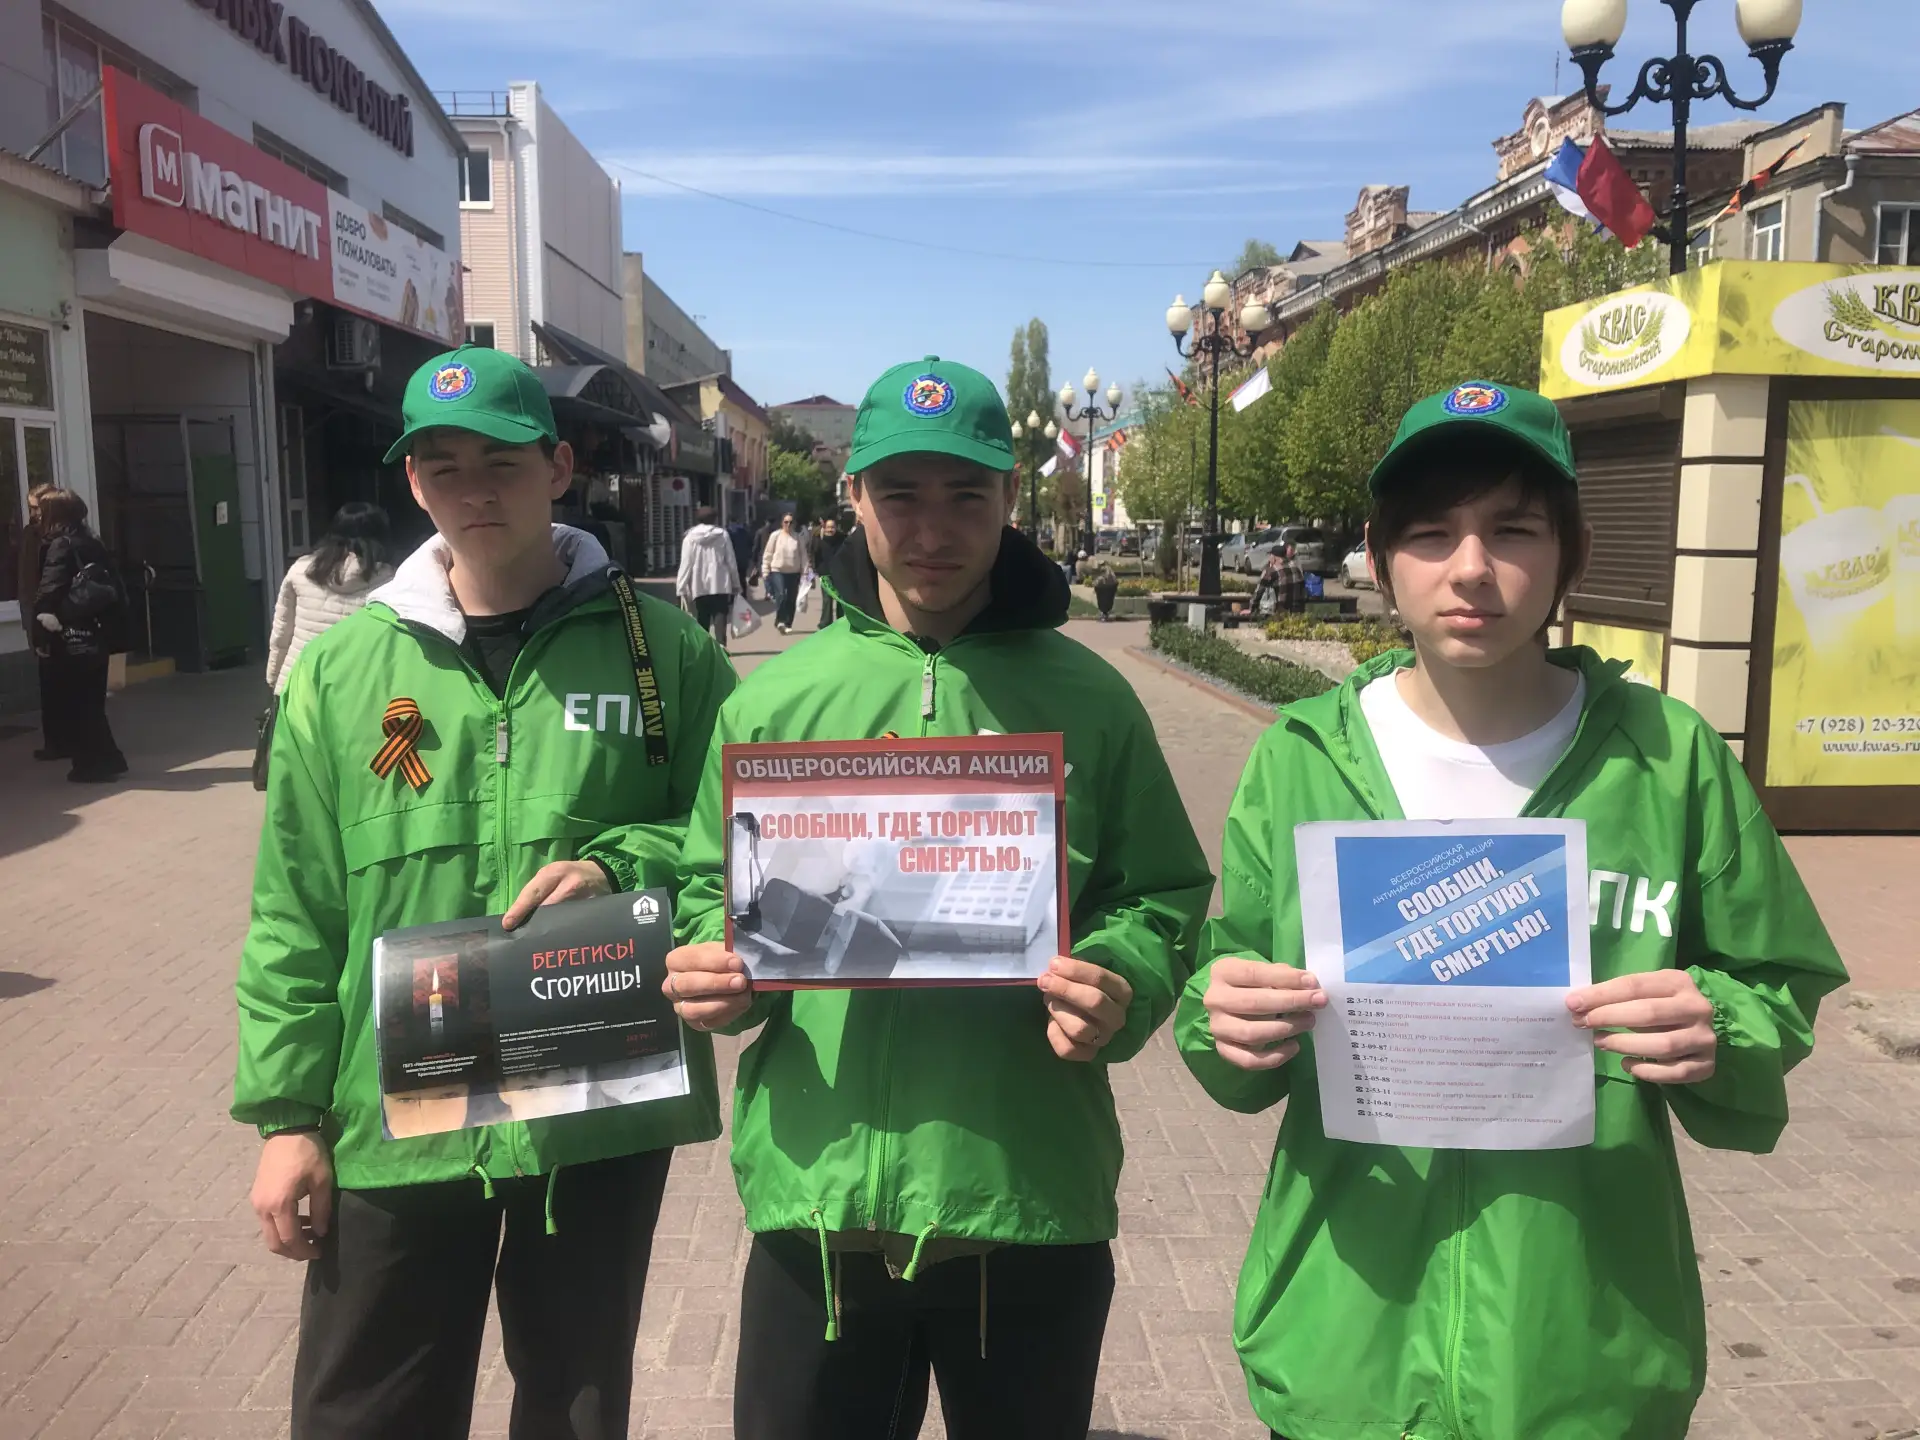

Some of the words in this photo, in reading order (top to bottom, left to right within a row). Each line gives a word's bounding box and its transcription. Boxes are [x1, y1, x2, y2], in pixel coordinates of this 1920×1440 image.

[288, 16, 414, 158] ПОКРЫТИЙ
[336, 210, 366, 241] ДОБРО
[1599, 304, 1647, 345] КВАС
[1579, 337, 1662, 381] Староминский
[1796, 719, 1816, 733] +7
[1820, 717, 1865, 735] (928)
[736, 752, 961, 781] ОБЩЕРОССИЙСКАЯ
[968, 754, 1049, 778] АКЦИЯ
[760, 812, 873, 841] СООБЩИ,
[877, 812, 922, 841] ГДЕ
[926, 810, 1038, 837] ТОРГУЮТ
[1372, 855, 1465, 906] АНТИНАРКОТИЧЕСКАЯ
[1465, 838, 1495, 859] АКЦИЯ
[1389, 843, 1465, 886] ВСЕРОССИЙСКАЯ
[1397, 856, 1505, 922] СООБЩИ,
[1394, 924, 1444, 962] ГДЕ
[1436, 872, 1542, 940] ТОРГУЮТ
[532, 938, 634, 971] БЕРЕГИСЬ!
[1430, 908, 1552, 983] СМЕРТЬЮ!
